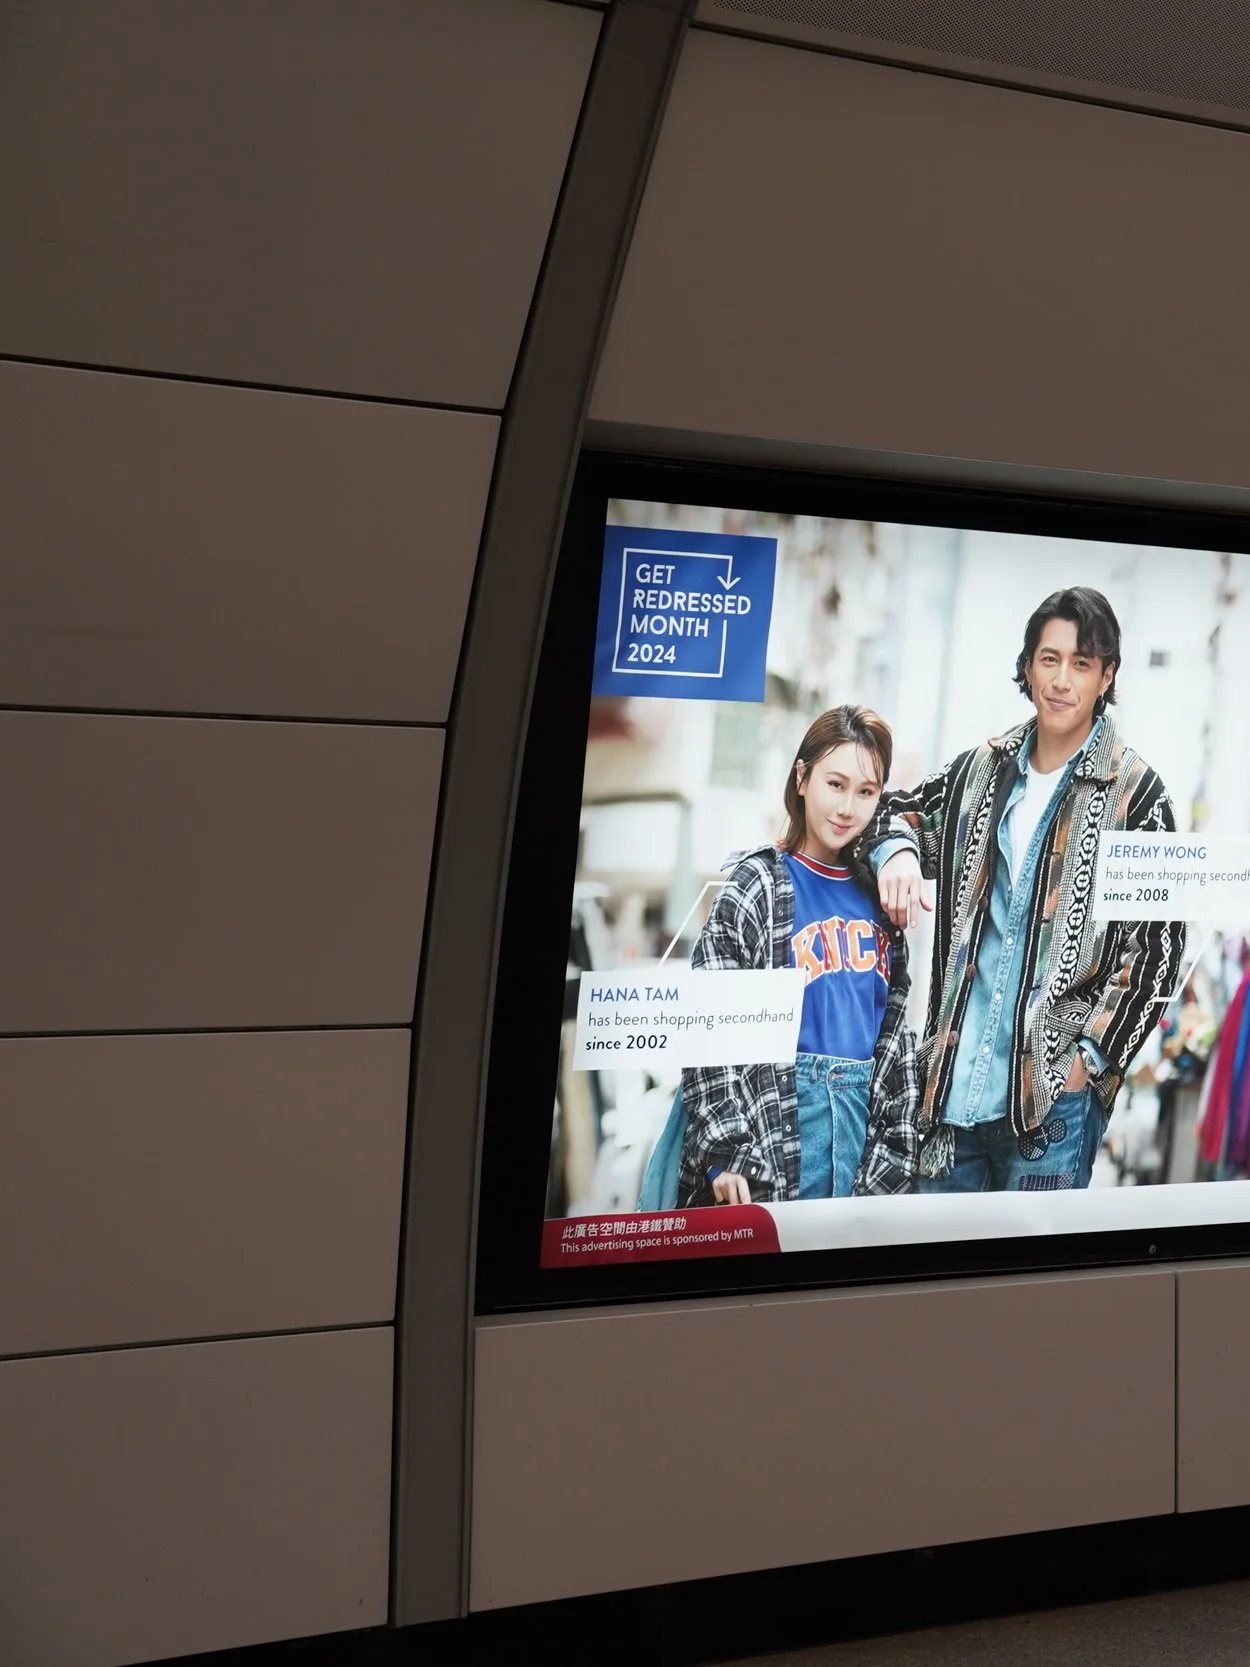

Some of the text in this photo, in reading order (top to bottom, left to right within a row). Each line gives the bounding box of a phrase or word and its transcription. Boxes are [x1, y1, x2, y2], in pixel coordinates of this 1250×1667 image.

[636, 563, 675, 584] GET
[633, 589, 751, 615] REDRESSED
[630, 615, 709, 638] MONTH
[627, 643, 676, 663] 2024
[1107, 845, 1207, 859] JEREMY WONG
[1105, 866, 1123, 880] has
[1127, 867, 1154, 880] been
[1158, 868, 1206, 886] shopping
[1103, 888, 1169, 901] since 2008
[591, 987, 679, 1002] HANA TAM
[588, 1008, 794, 1030] has been shopping secondhand
[586, 1035, 667, 1050] since 2002
[560, 1228, 754, 1253] This advertising space is sponsored by MTR
